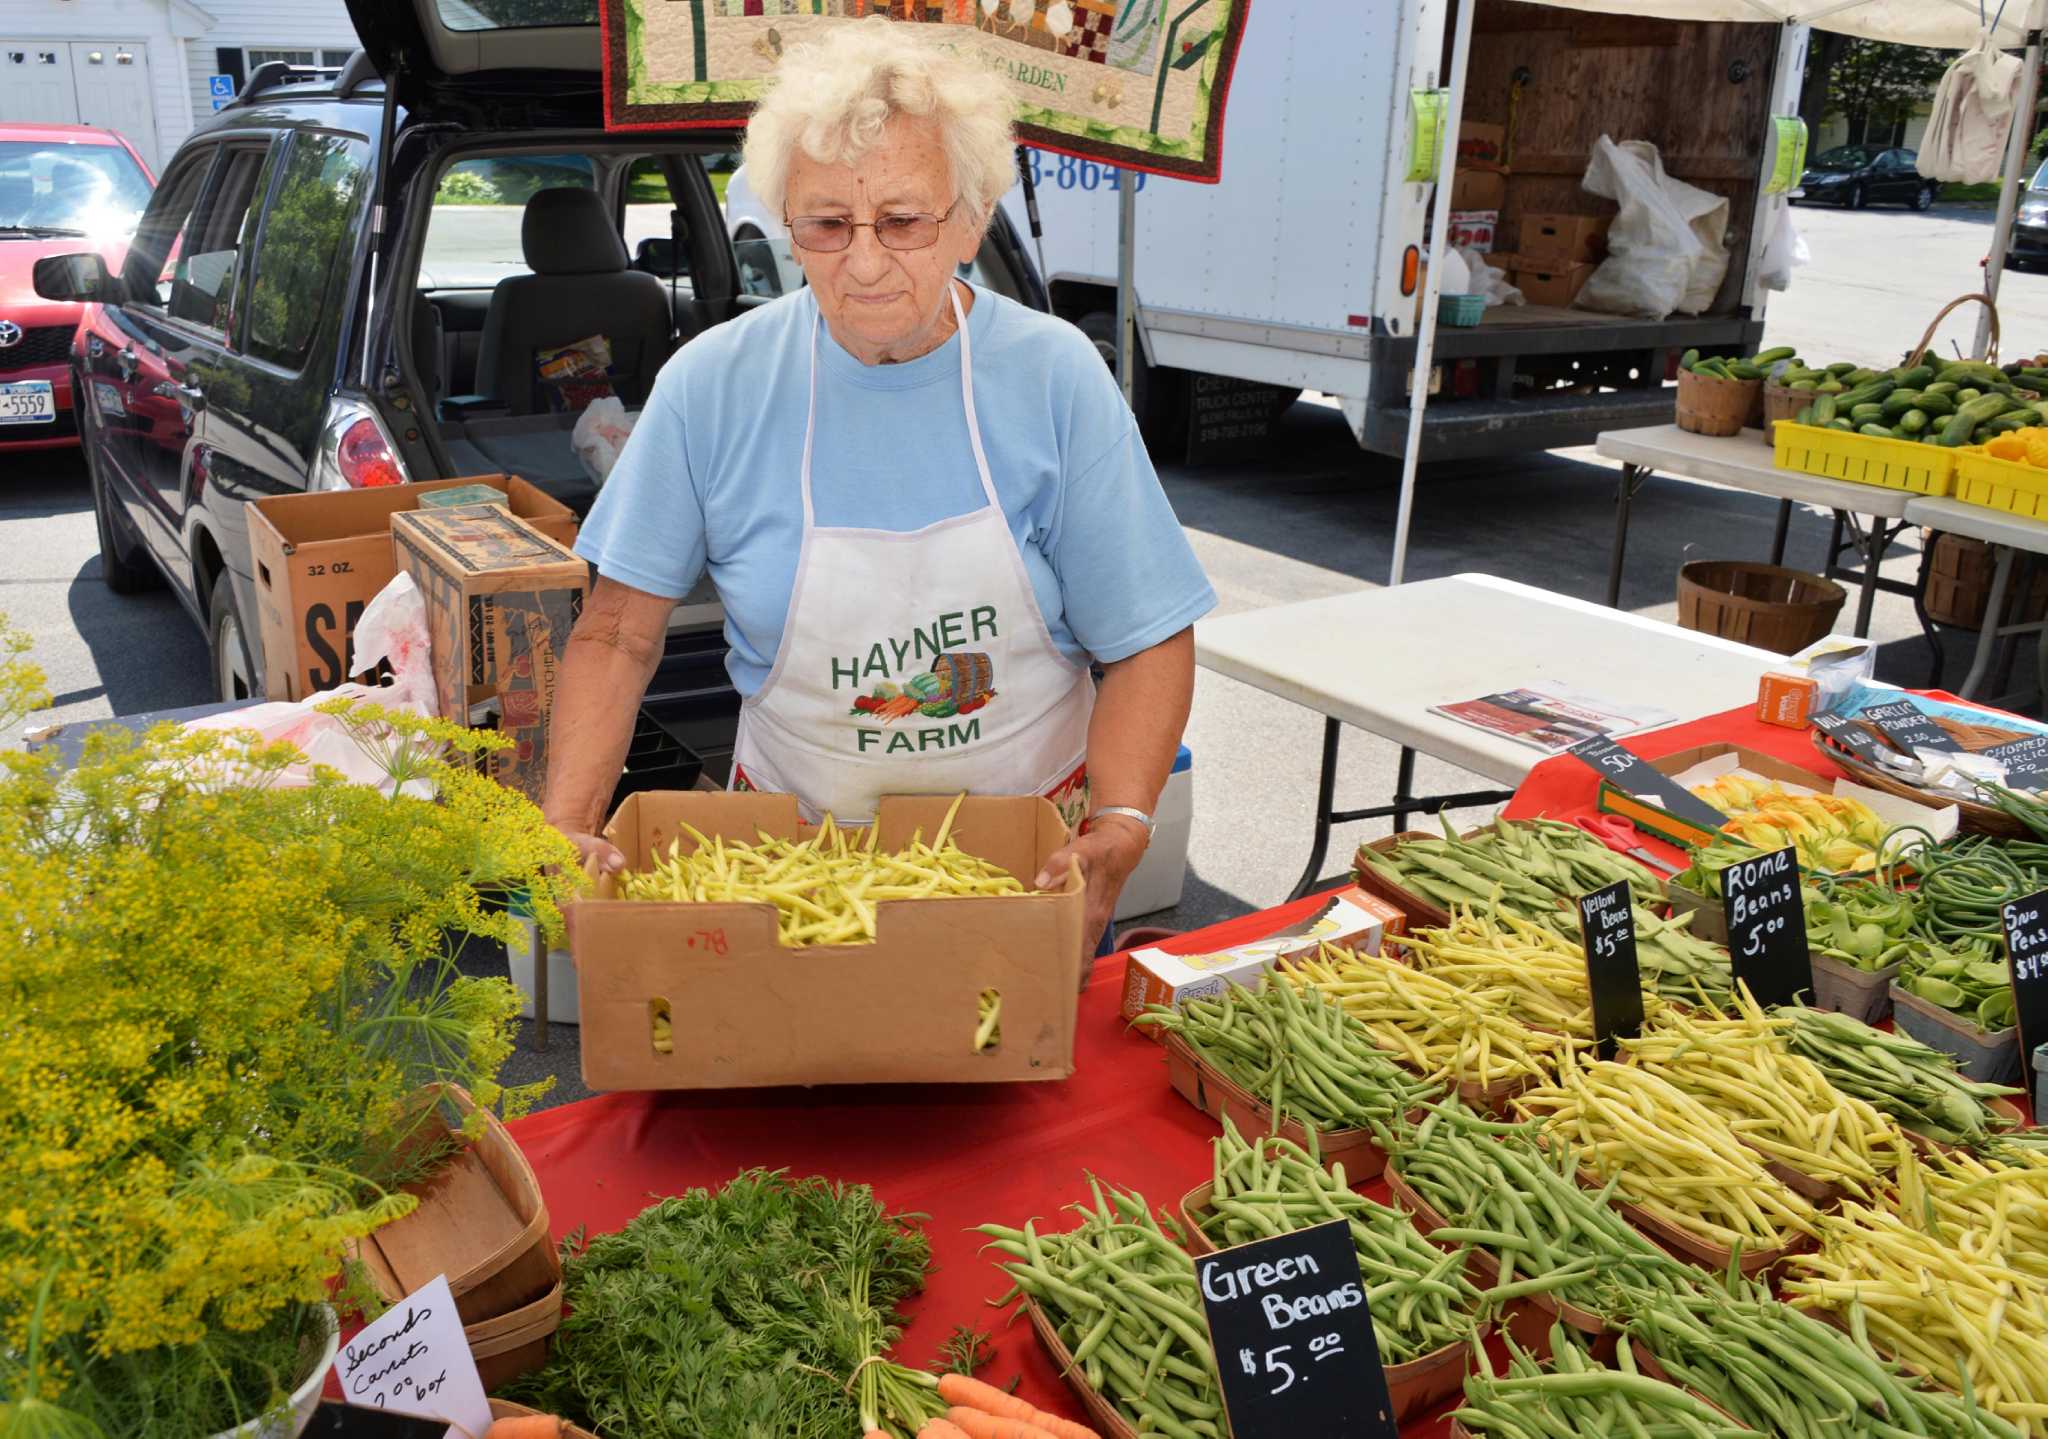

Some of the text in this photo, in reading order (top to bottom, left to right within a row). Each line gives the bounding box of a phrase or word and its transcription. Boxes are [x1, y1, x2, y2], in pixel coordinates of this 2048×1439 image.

[307, 565, 325, 576] 32
[831, 605, 998, 689] HAYNER
[857, 718, 980, 754] FARM
[2003, 749, 2048, 768] ARLIC
[1731, 883, 1792, 928] Beans
[1202, 1254, 1320, 1302] Green
[1260, 1282, 1363, 1330] Beans
[345, 1307, 432, 1378] Seconds
[416, 1369, 447, 1401] box
